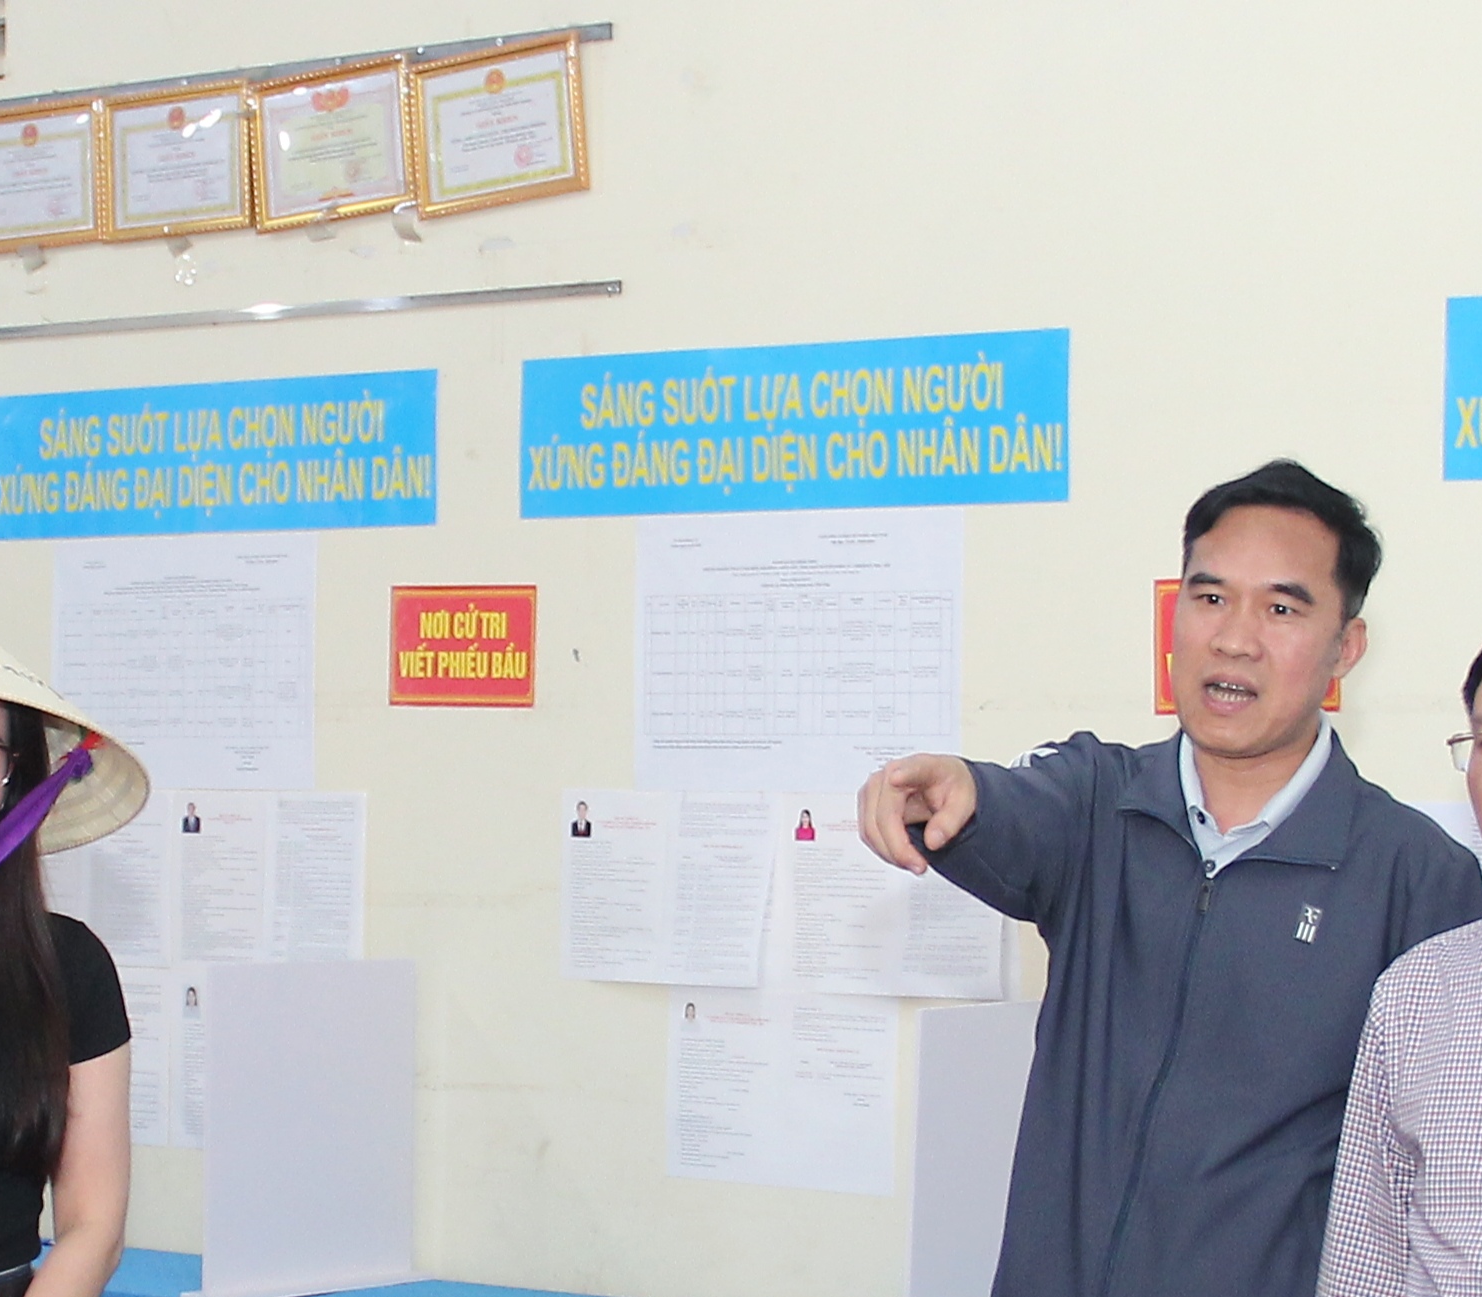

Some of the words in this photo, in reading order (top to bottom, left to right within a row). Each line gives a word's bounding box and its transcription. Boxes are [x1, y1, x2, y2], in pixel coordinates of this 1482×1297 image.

[40, 408, 102, 459] SÁNG
[107, 403, 169, 455] SUỐT
[174, 409, 223, 461] LỰA
[228, 404, 295, 457] CHỌN
[302, 389, 384, 445] NGƯỜI
[581, 372, 655, 428] SÁNG
[663, 366, 736, 425] SUỐT
[744, 373, 804, 431] LỰA
[810, 368, 893, 426] CHỌN
[903, 351, 1003, 413] NGƯỜI
[64, 462, 129, 512] ĐÁNG
[134, 468, 172, 518] ĐẠI
[178, 461, 233, 516] DIỆN
[238, 462, 291, 504] CHO
[297, 450, 364, 502] NHÂN
[372, 447, 431, 499] DÂN!
[529, 436, 605, 490] XỨNG
[612, 432, 690, 487] ĐÁNG
[697, 438, 744, 494] ĐẠI
[752, 430, 817, 492] DIỆN
[826, 432, 889, 479] CHO
[897, 418, 980, 476] NHÂN
[989, 414, 1062, 473] DÂN!
[419, 609, 450, 639] NƠI
[453, 602, 479, 639] CỬ
[479, 611, 507, 639] TRI
[399, 642, 435, 678] VIẾT
[437, 642, 488, 678] PHIẾU
[491, 642, 528, 679] BẦU
